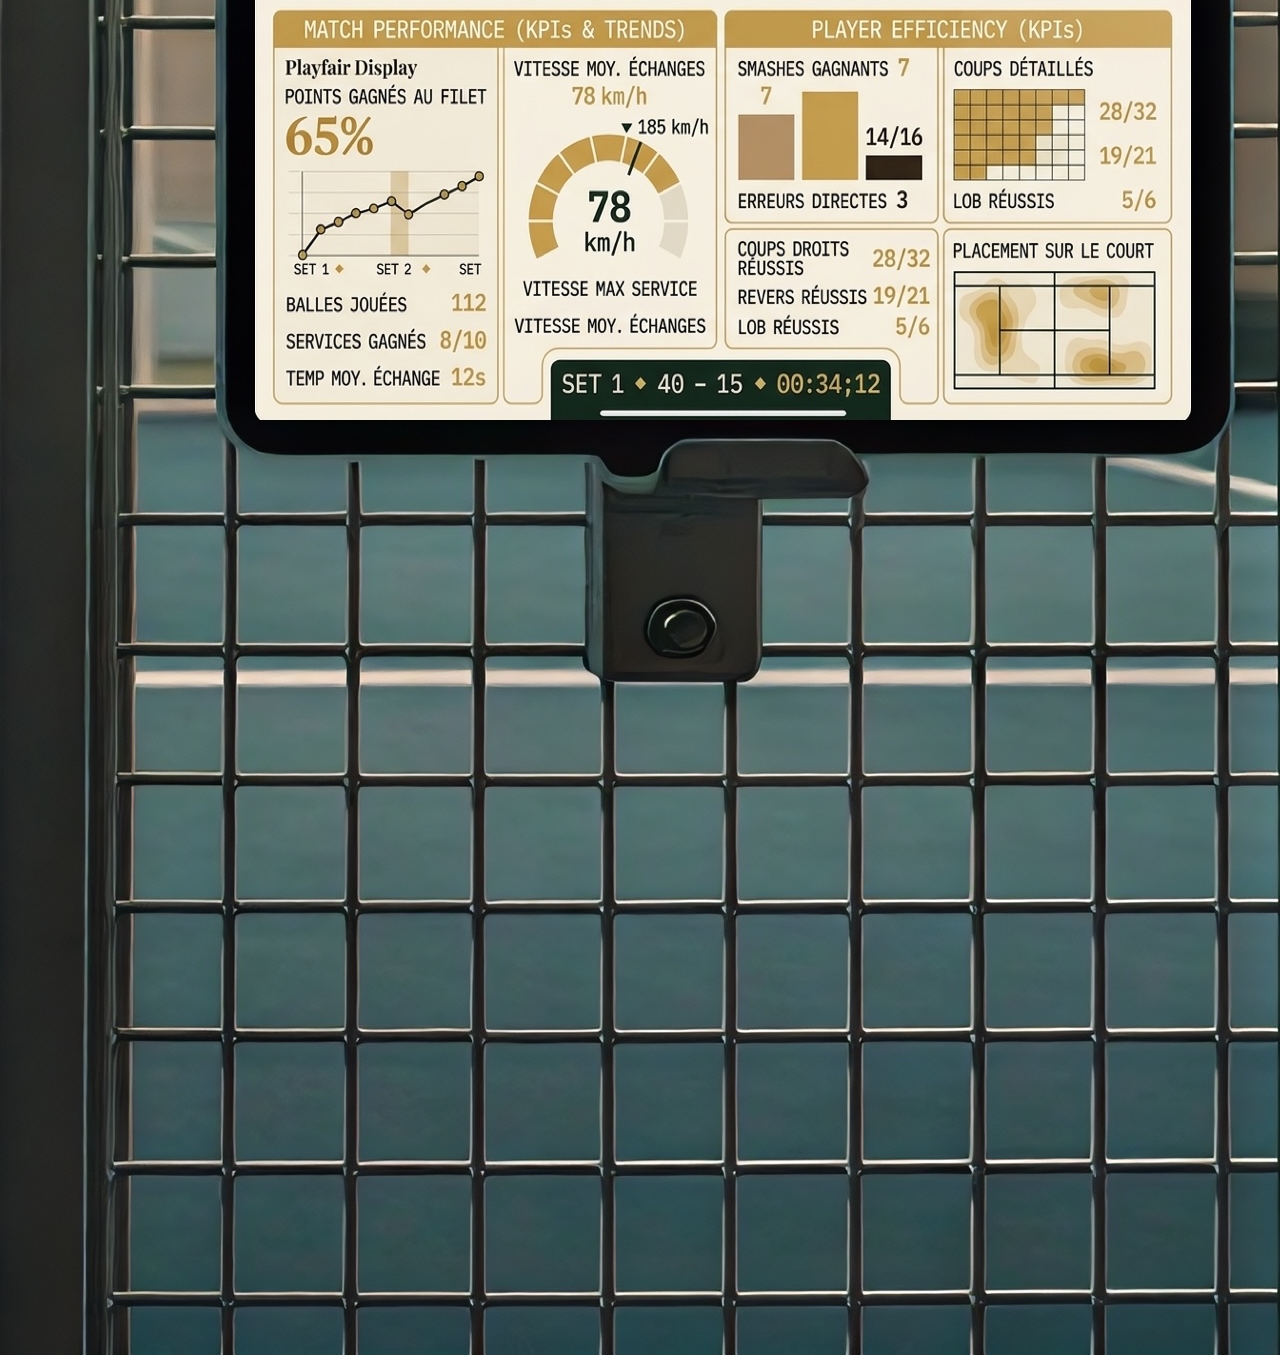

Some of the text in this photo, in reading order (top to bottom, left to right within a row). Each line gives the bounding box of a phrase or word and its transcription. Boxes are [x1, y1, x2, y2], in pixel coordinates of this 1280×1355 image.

[305, 19, 684, 42] MATCH PERFORMANCE (KPIs & TRENDS)
[813, 19, 1082, 42] PLAYER EFFICIENCY (KPIs)
[286, 59, 417, 79] Playfair Display
[514, 56, 705, 76] VITESSE MOY. ÉCHANGES
[738, 58, 909, 76] SMASHES GAGNANTS 7
[955, 56, 1093, 76] COUPS DÉTAILLÉS
[286, 84, 486, 104] POINTS GAGNÉS AU FILET
[572, 86, 646, 108] 78 km/h
[761, 86, 772, 105] 7
[1100, 101, 1156, 123] 28/32
[286, 116, 373, 155] 65%
[639, 118, 708, 137] 185 km/h
[866, 126, 922, 148] 14/16
[1100, 145, 1156, 168] 19/21
[589, 190, 630, 223] 78
[739, 190, 907, 208] ERREURS DIRECTES 3
[954, 189, 1054, 208] LOB RÉUSSIS
[1122, 189, 1156, 211] 5/6
[585, 231, 634, 256] km/h
[738, 241, 849, 257] COUPS DROITS
[954, 243, 1154, 258] PLACEMENT SUR LE COURT
[294, 263, 329, 275] SET 1
[377, 263, 411, 275] SET 2
[460, 263, 481, 275] SET
[739, 257, 805, 275] RÉUSSIS
[873, 248, 930, 270] 28/32
[523, 281, 697, 296] VITESSE MAX SERVICE
[739, 285, 867, 304] REVERS RÉUSSIS
[874, 285, 930, 307] 19/21
[287, 292, 407, 312] BALLES JOUÉES
[452, 293, 486, 311] 112
[515, 314, 706, 333] VITESSE MOY. ÉCHANGES
[739, 315, 839, 335] LOB RÉUSSIS
[896, 316, 930, 338] 5/6
[287, 329, 426, 349] SERVICES GAGNÉS
[440, 330, 486, 352] 8/10
[286, 366, 440, 386] TEMP MOY. ÉCHANGE
[452, 367, 485, 386] 12s
[563, 374, 602, 393] SET
[612, 374, 624, 393] 1
[658, 374, 683, 393] 40
[718, 374, 742, 393] 15
